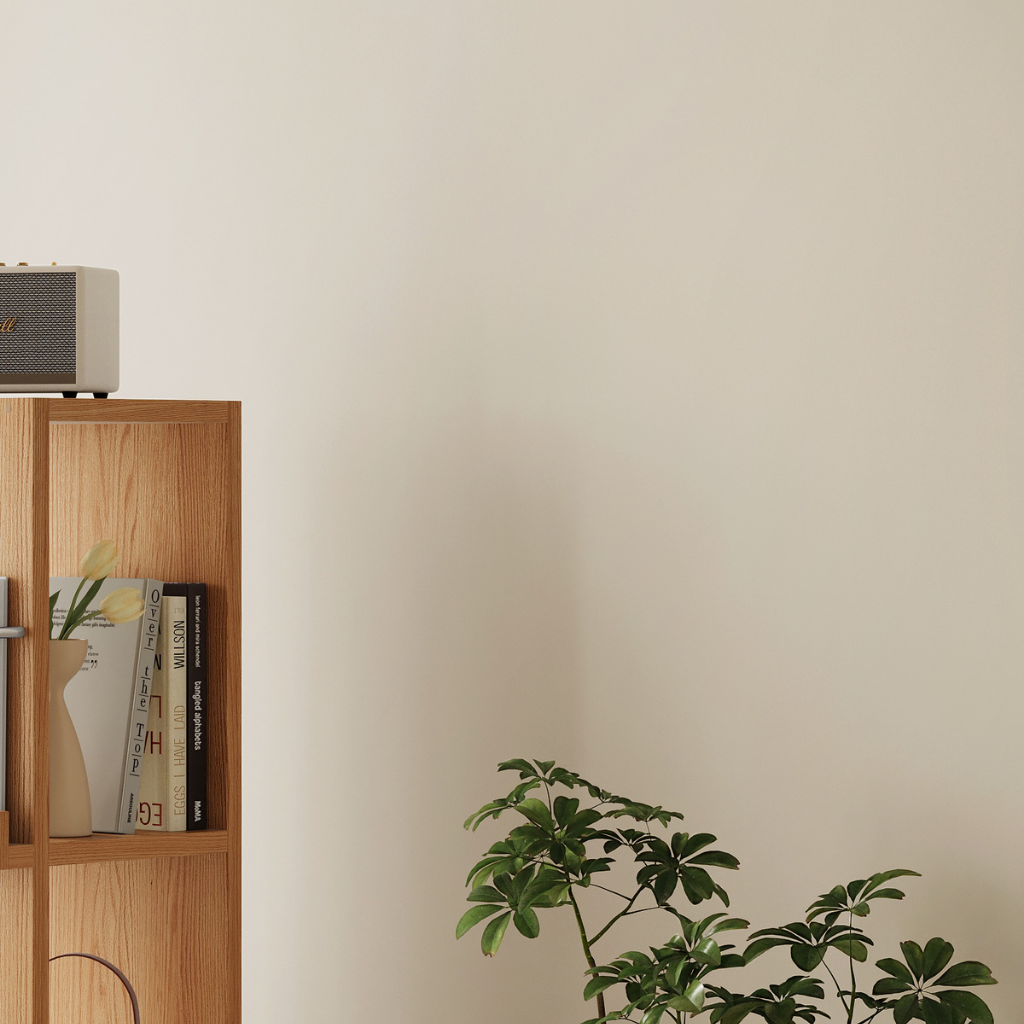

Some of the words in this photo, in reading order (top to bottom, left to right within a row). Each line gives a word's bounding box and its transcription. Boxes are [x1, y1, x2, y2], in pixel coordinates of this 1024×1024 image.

[148, 589, 160, 647] Over
[173, 620, 185, 670] WILLSON
[140, 665, 149, 708] the
[192, 681, 202, 711] tangled
[174, 705, 185, 730] LAID
[193, 712, 202, 751] alphabets
[174, 738, 185, 766] HAVE
[174, 785, 185, 816] EGGS
